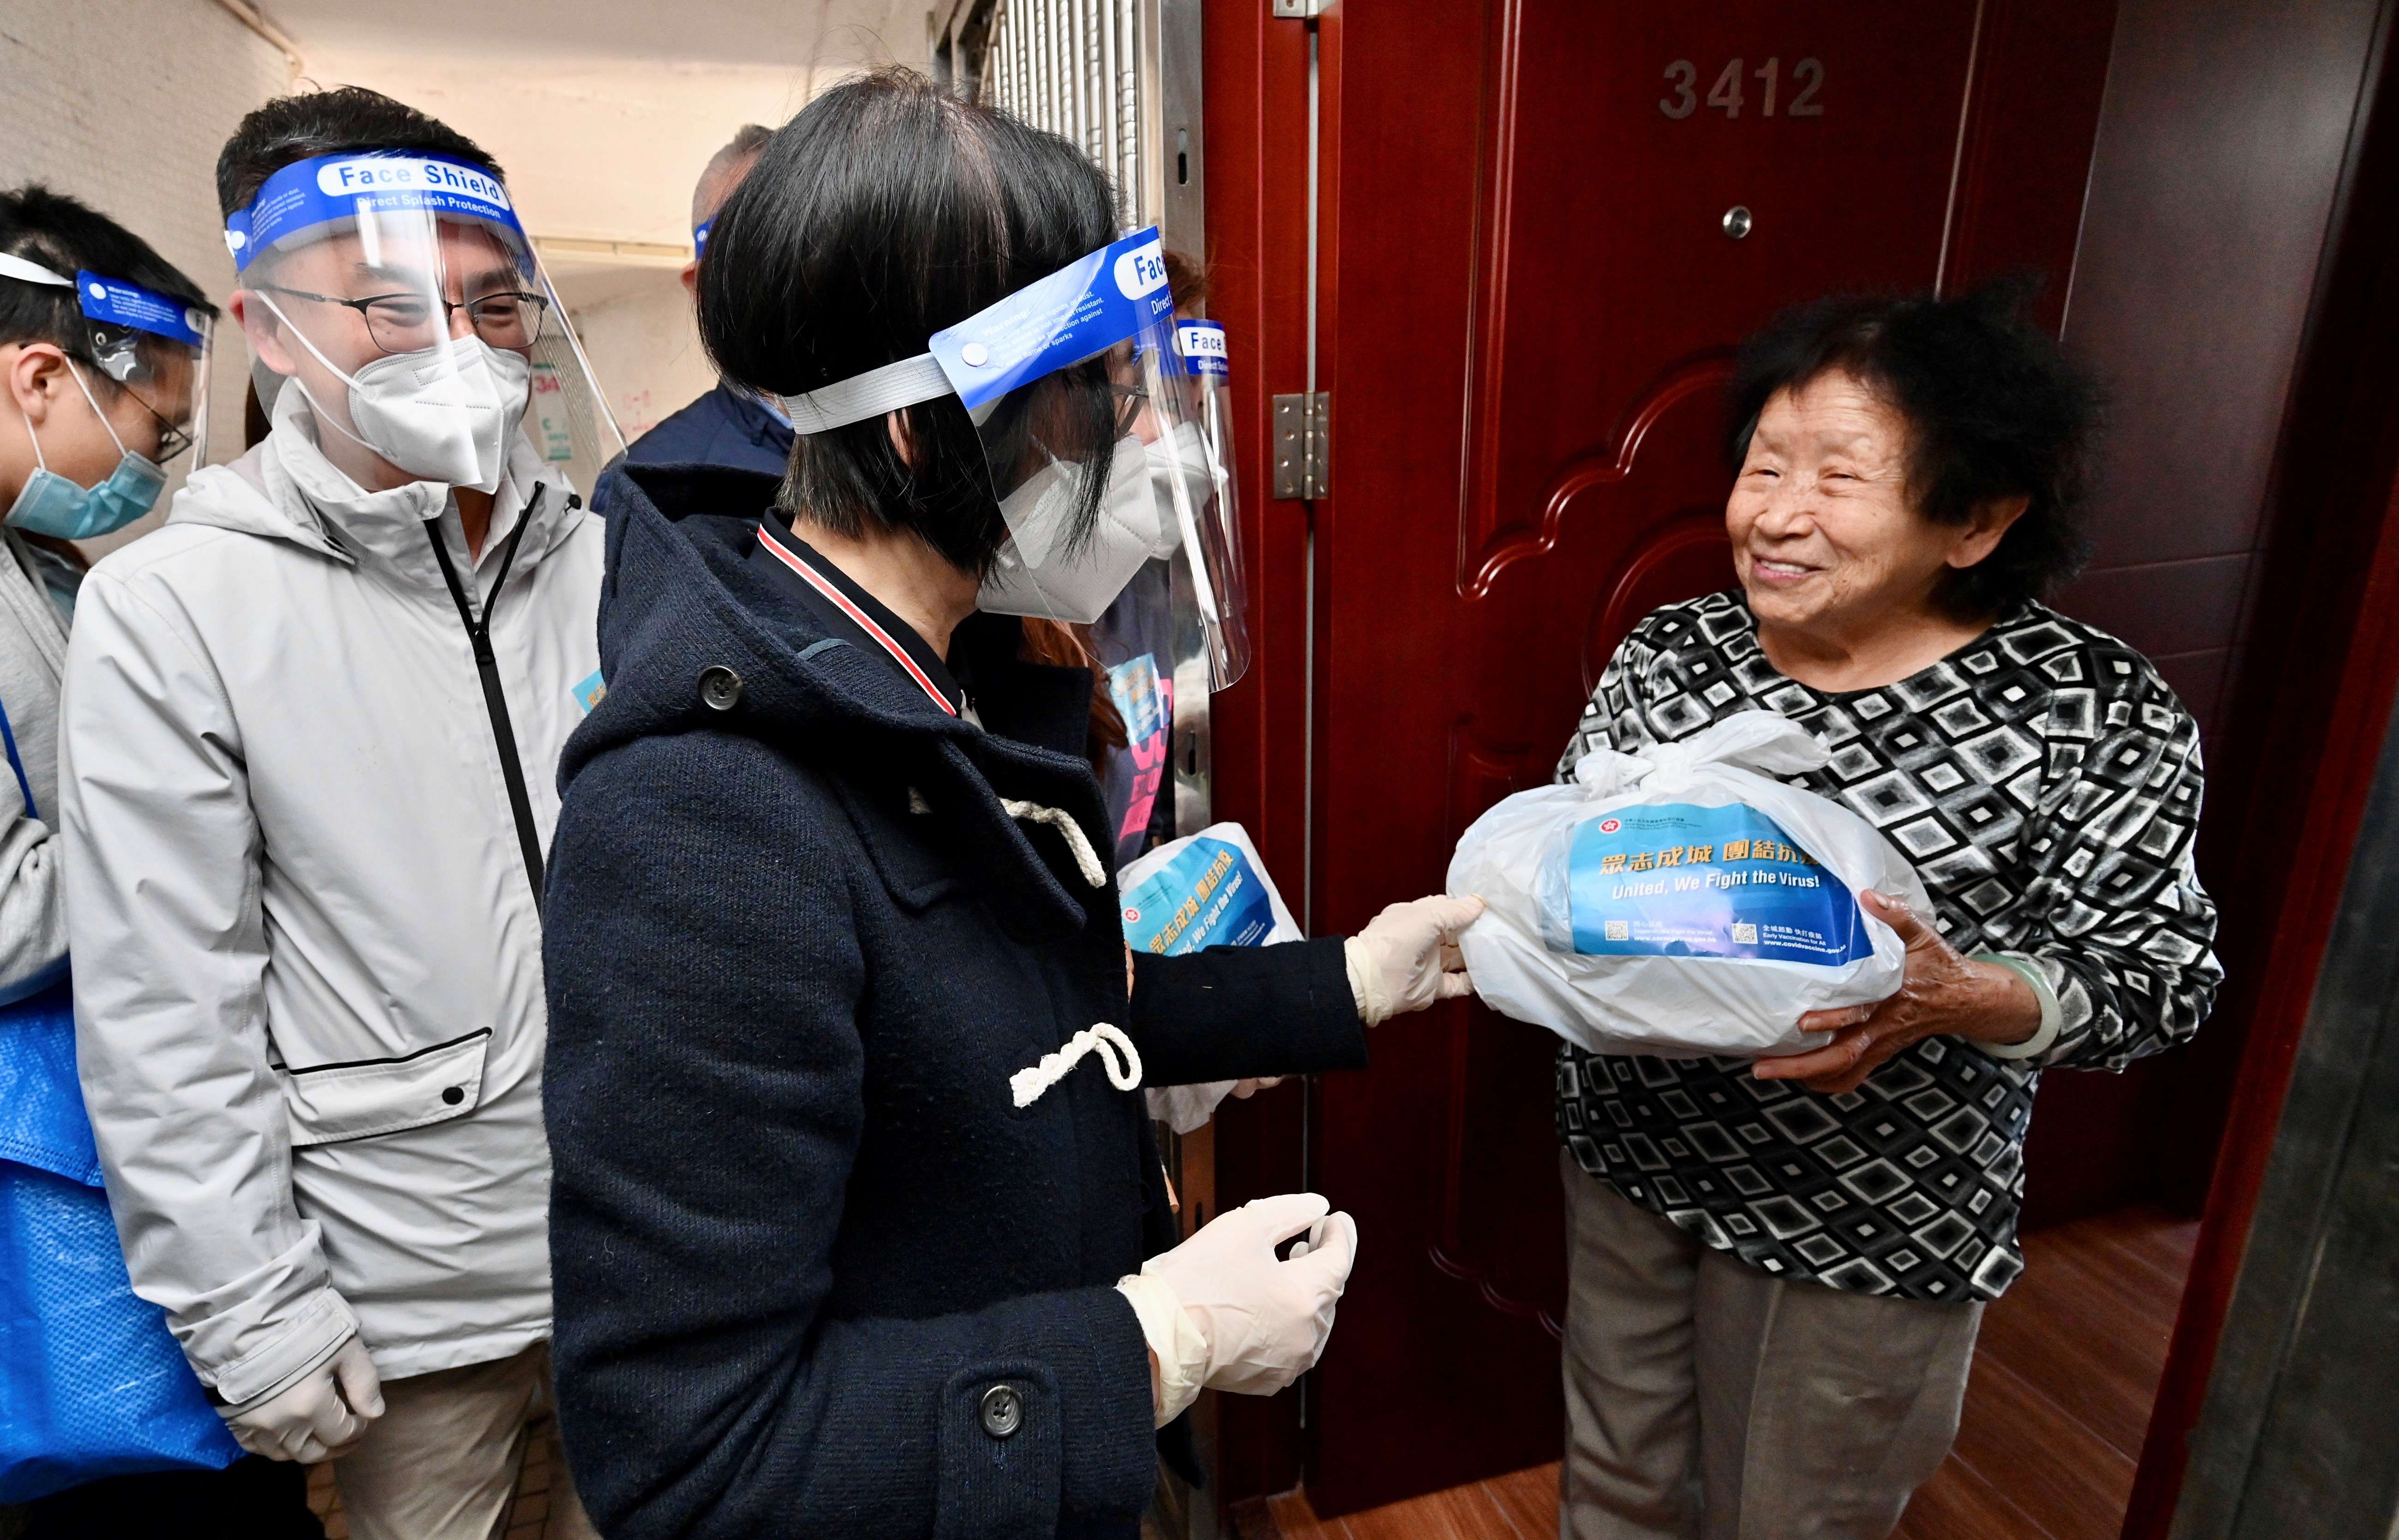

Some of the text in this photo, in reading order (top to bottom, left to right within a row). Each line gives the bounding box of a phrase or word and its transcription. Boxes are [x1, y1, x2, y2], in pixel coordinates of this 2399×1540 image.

[1659, 57, 1824, 119] 3412
[339, 164, 500, 201] Face Shield
[356, 194, 501, 219] Direct Splash Protection
[1134, 253, 1166, 285] Fac
[1041, 321, 1052, 330] not
[1053, 310, 1076, 324] impact
[1076, 297, 1105, 314] resistant.
[1046, 303, 1069, 318] liquids
[1078, 291, 1095, 302] dust.
[1151, 294, 1171, 315] Direct
[1046, 318, 1080, 338] protection
[1080, 308, 1103, 322] against
[1051, 332, 1073, 346] sparks
[1190, 332, 1221, 351] Face
[1599, 845, 1713, 875] 眾志成城
[1612, 869, 1820, 900] United, We Fight the Virus!
[1192, 926, 1207, 944] We
[1203, 904, 1221, 930] Fight
[1217, 893, 1230, 911] the
[1226, 870, 1243, 898] Virus!
[1778, 934, 1810, 943] Vaccination
